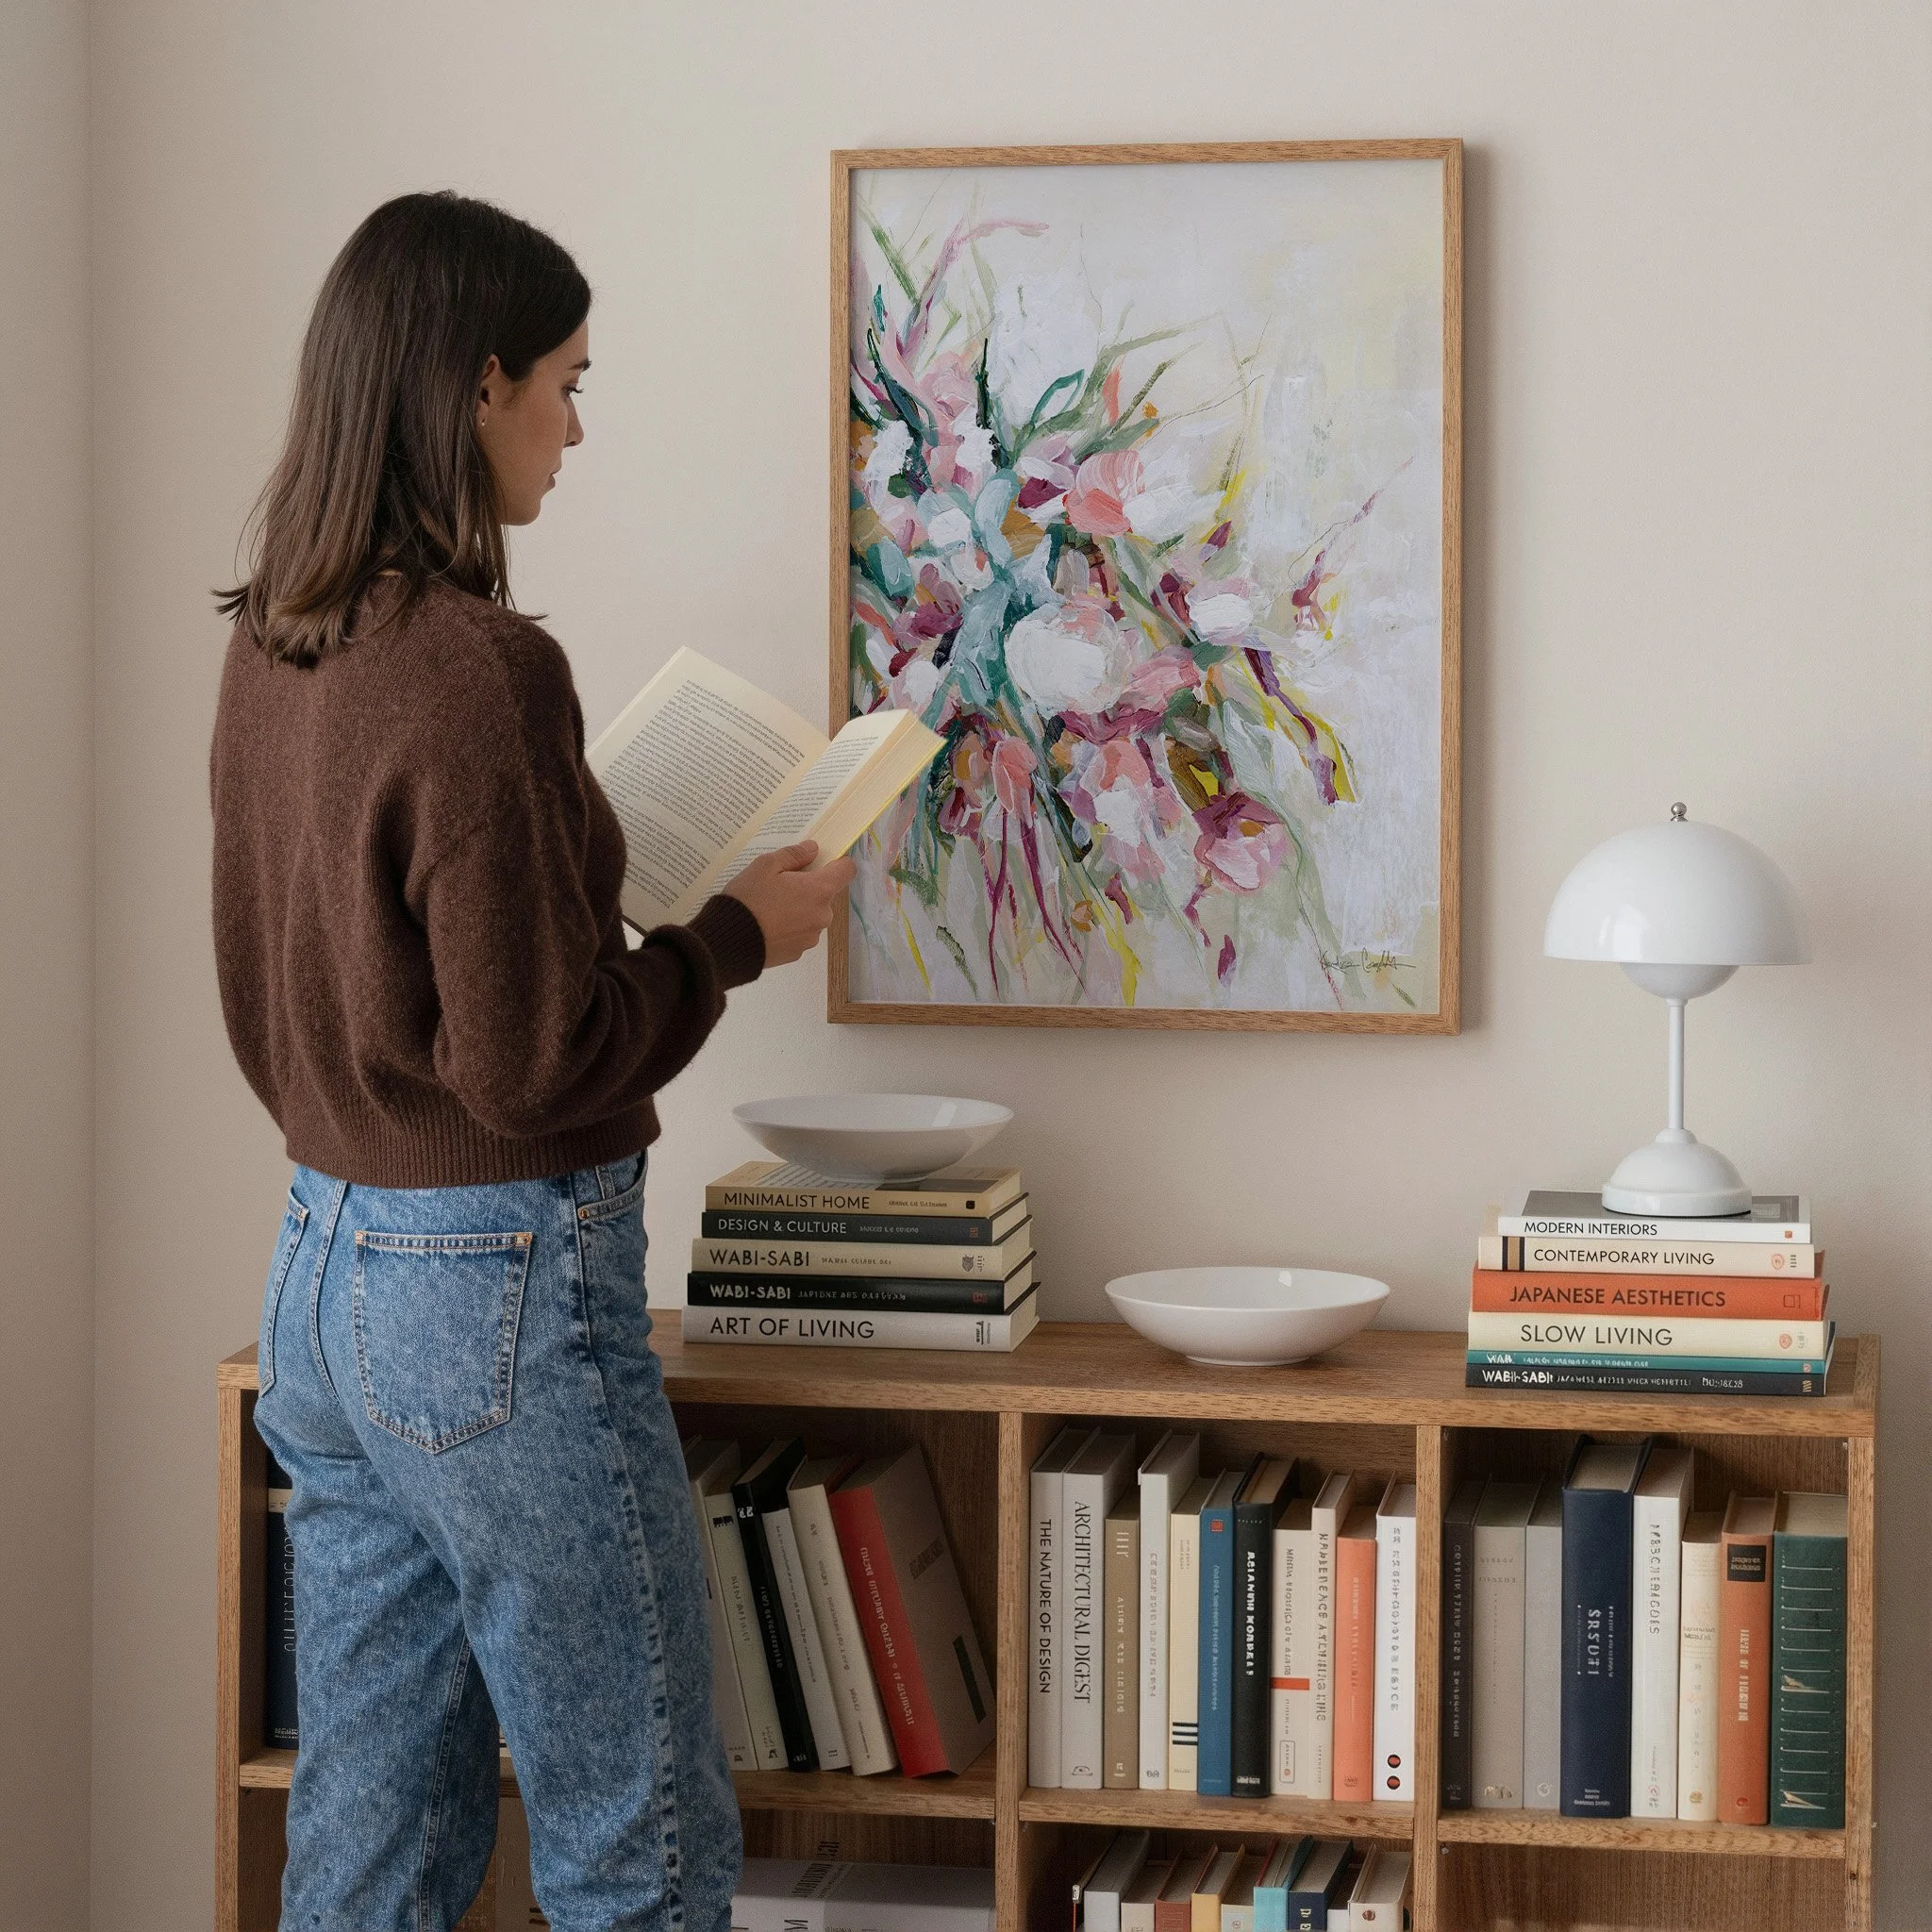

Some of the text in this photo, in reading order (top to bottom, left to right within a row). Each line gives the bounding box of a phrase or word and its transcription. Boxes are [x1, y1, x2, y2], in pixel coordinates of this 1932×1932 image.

[724, 1191, 818, 1208] MINIMALIST
[822, 1194, 870, 1209] HOME
[718, 1218, 769, 1232] DESIGN
[773, 1220, 783, 1233] &
[787, 1220, 847, 1234] CULTURE
[1524, 1221, 1657, 1237] MODERN INTERIORS
[709, 1248, 809, 1267] WABI-SABI
[1534, 1248, 1715, 1265] CONTEMPORARY LIVING
[709, 1284, 791, 1300] WABI-SABI
[1509, 1286, 1726, 1307] JAPANESE AESTHETICS
[709, 1317, 874, 1340] ART OF LIVING
[1520, 1324, 1674, 1346] SLOW LIVING
[1039, 1519, 1052, 1694] THE NATURE OF DESIGN
[1074, 1500, 1091, 1704] ARCHITECTURAL DIGEST
